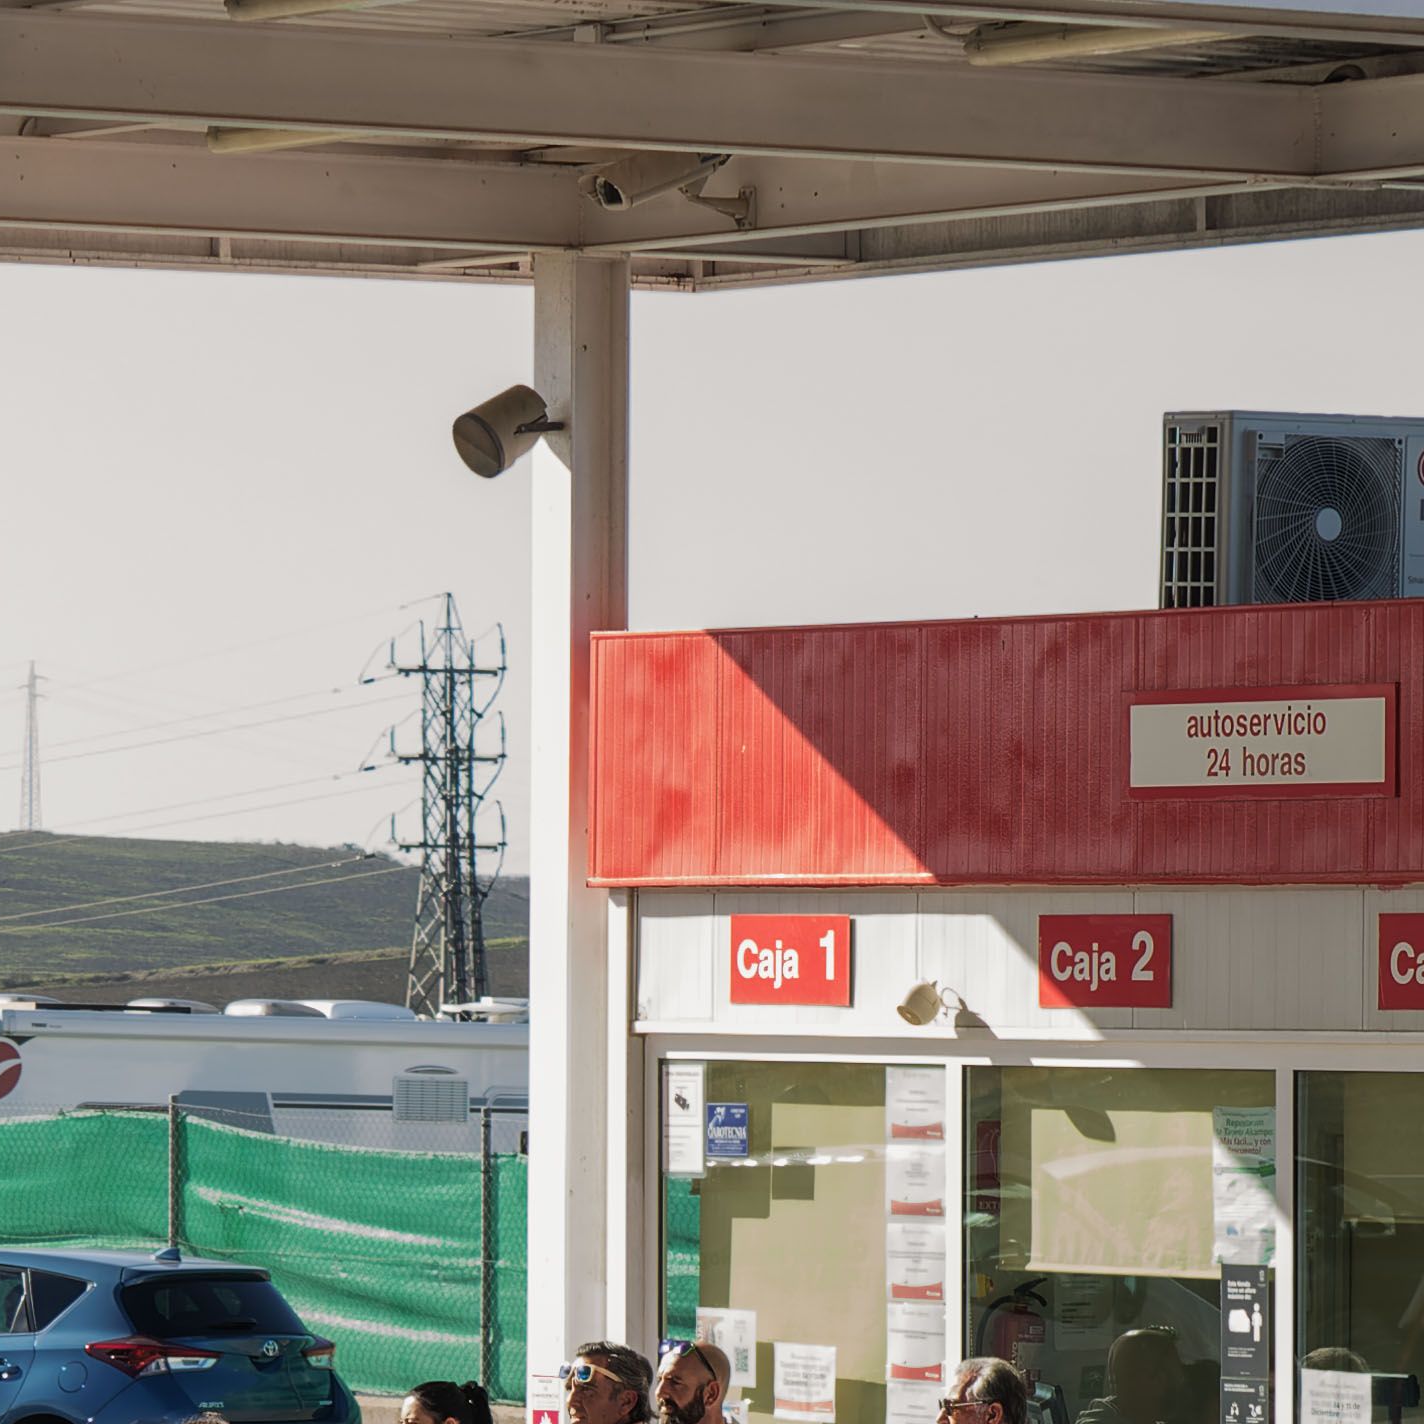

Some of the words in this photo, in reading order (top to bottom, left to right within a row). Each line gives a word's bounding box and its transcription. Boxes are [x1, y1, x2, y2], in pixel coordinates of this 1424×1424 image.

[1187, 704, 1327, 738] autoservicio
[1207, 748, 1231, 777] 24
[1242, 746, 1306, 776] horas
[737, 938, 799, 990] Caja
[819, 929, 835, 981] 1
[1050, 941, 1116, 992] Caja
[1131, 930, 1154, 981] 2
